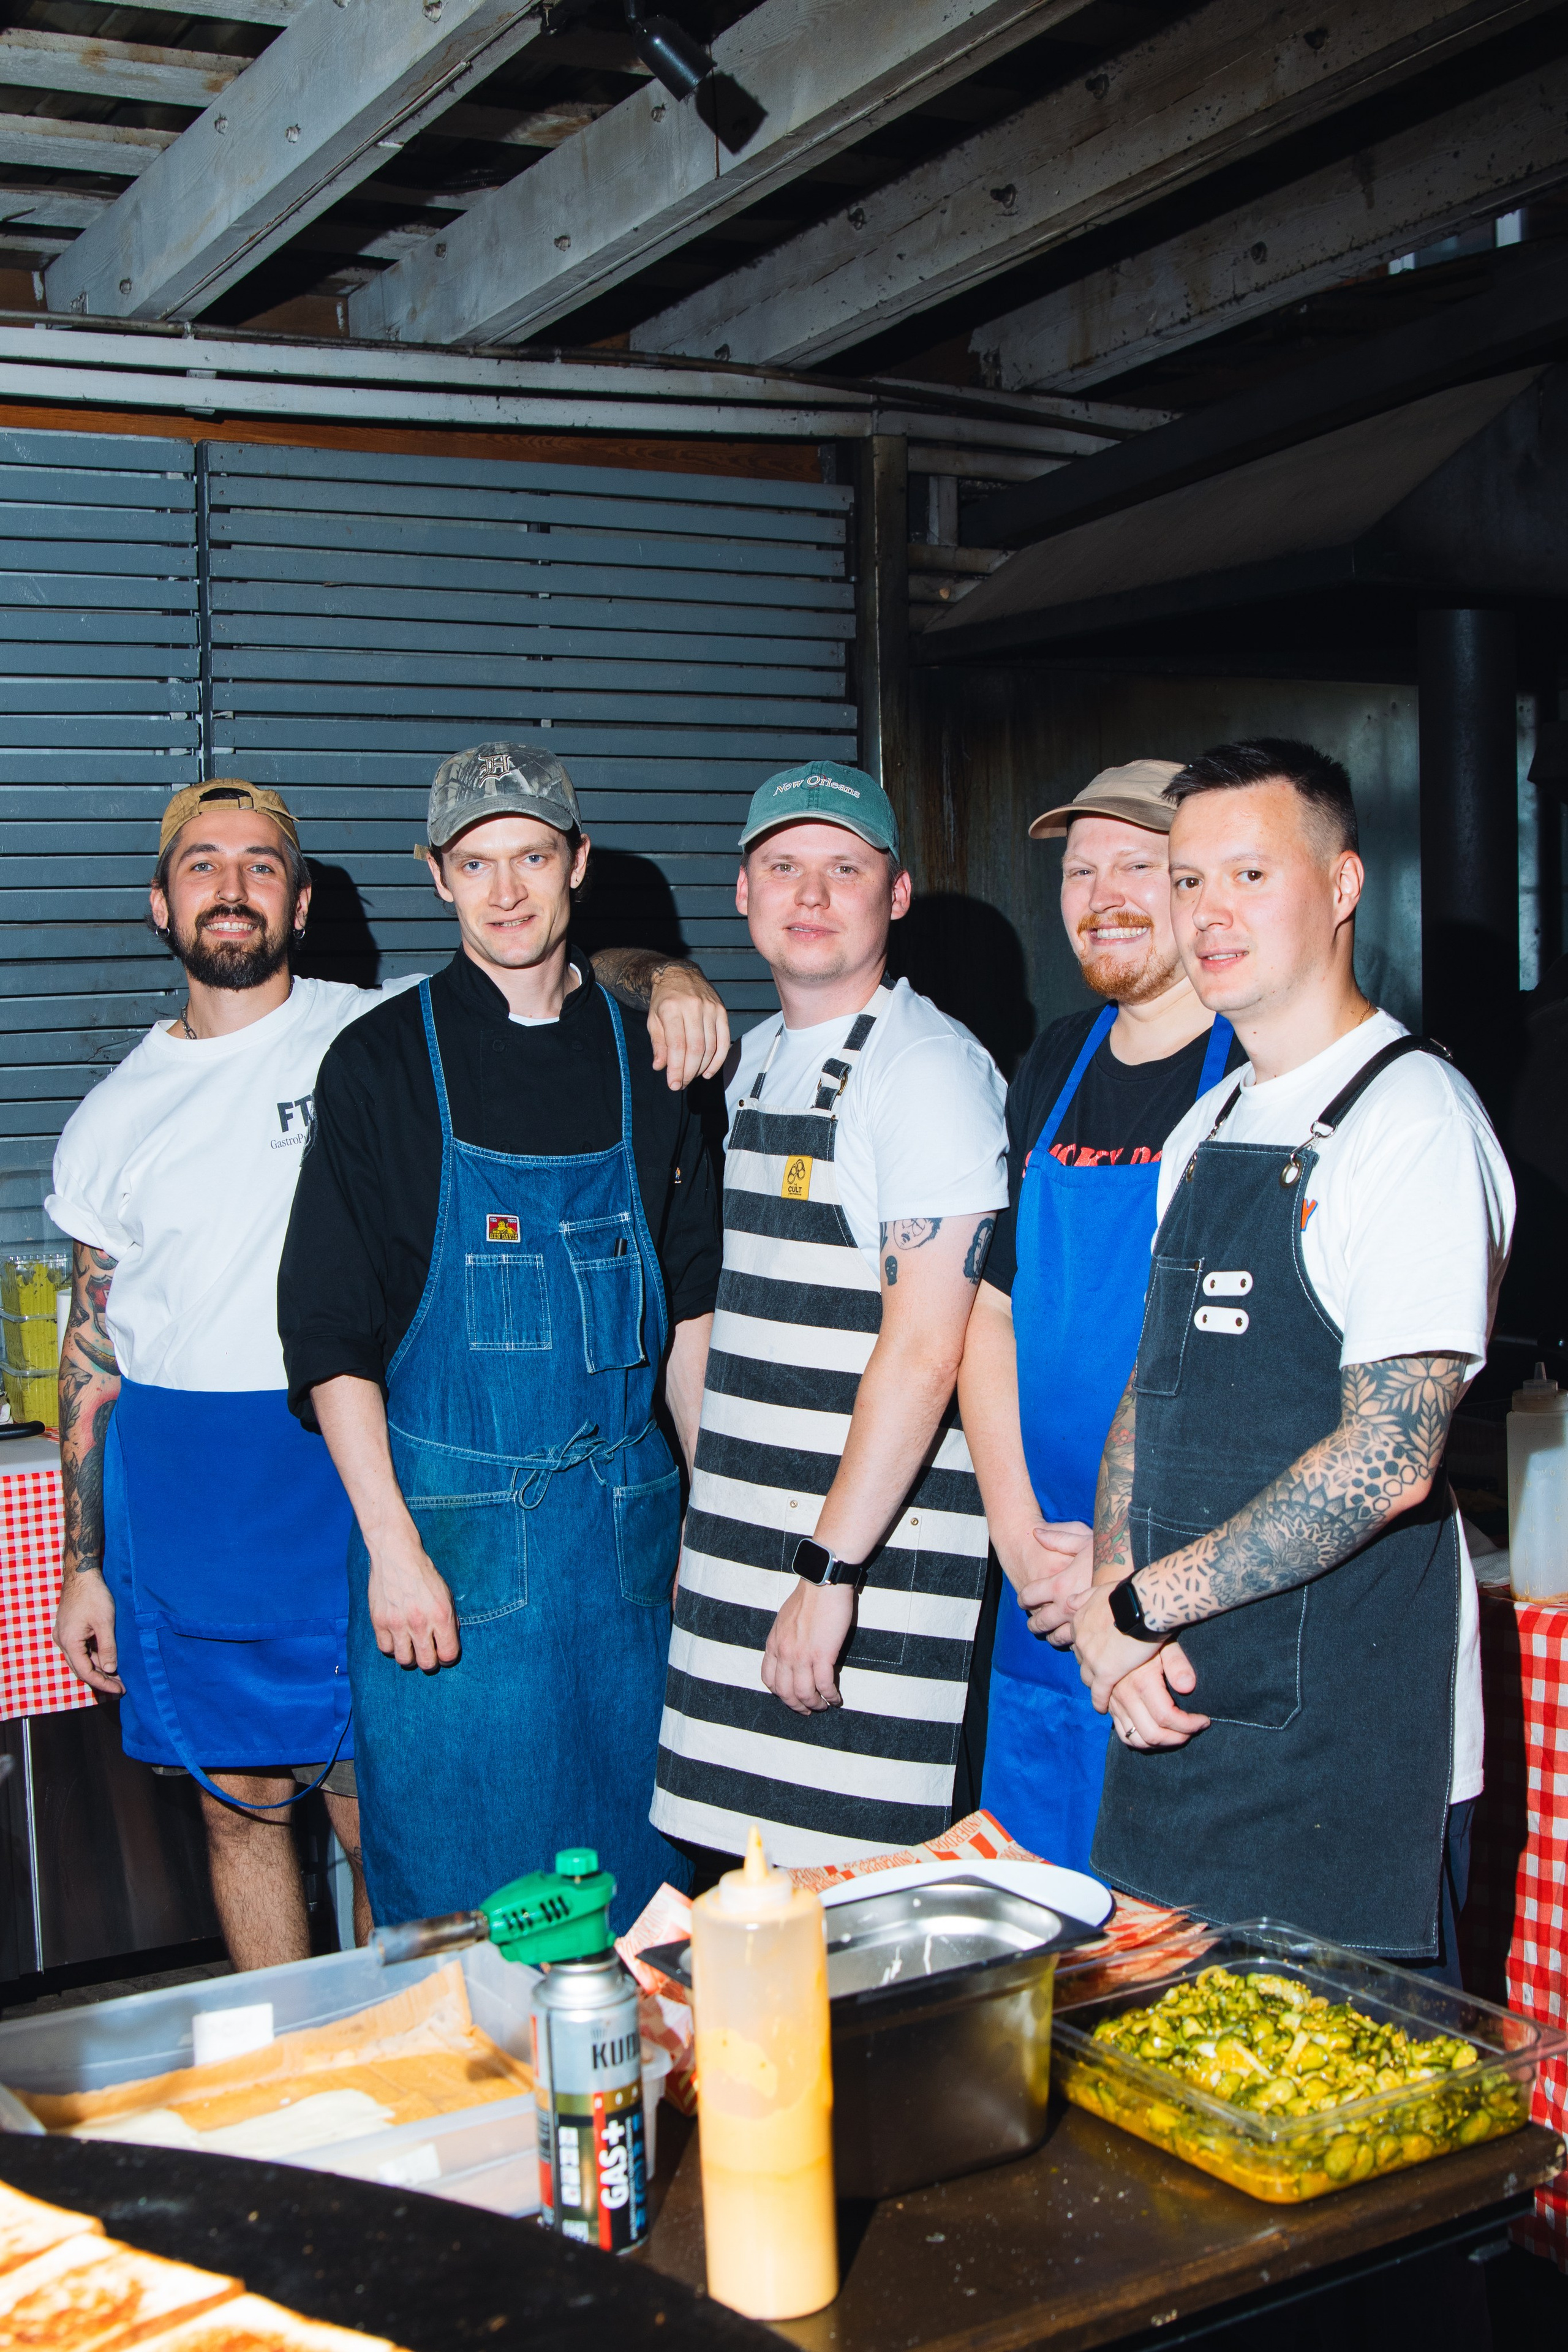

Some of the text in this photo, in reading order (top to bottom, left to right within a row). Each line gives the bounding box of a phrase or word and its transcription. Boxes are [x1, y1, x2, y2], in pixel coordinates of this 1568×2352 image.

[773, 775, 860, 798] New Orleans
[270, 1133, 307, 1150] GastroP
